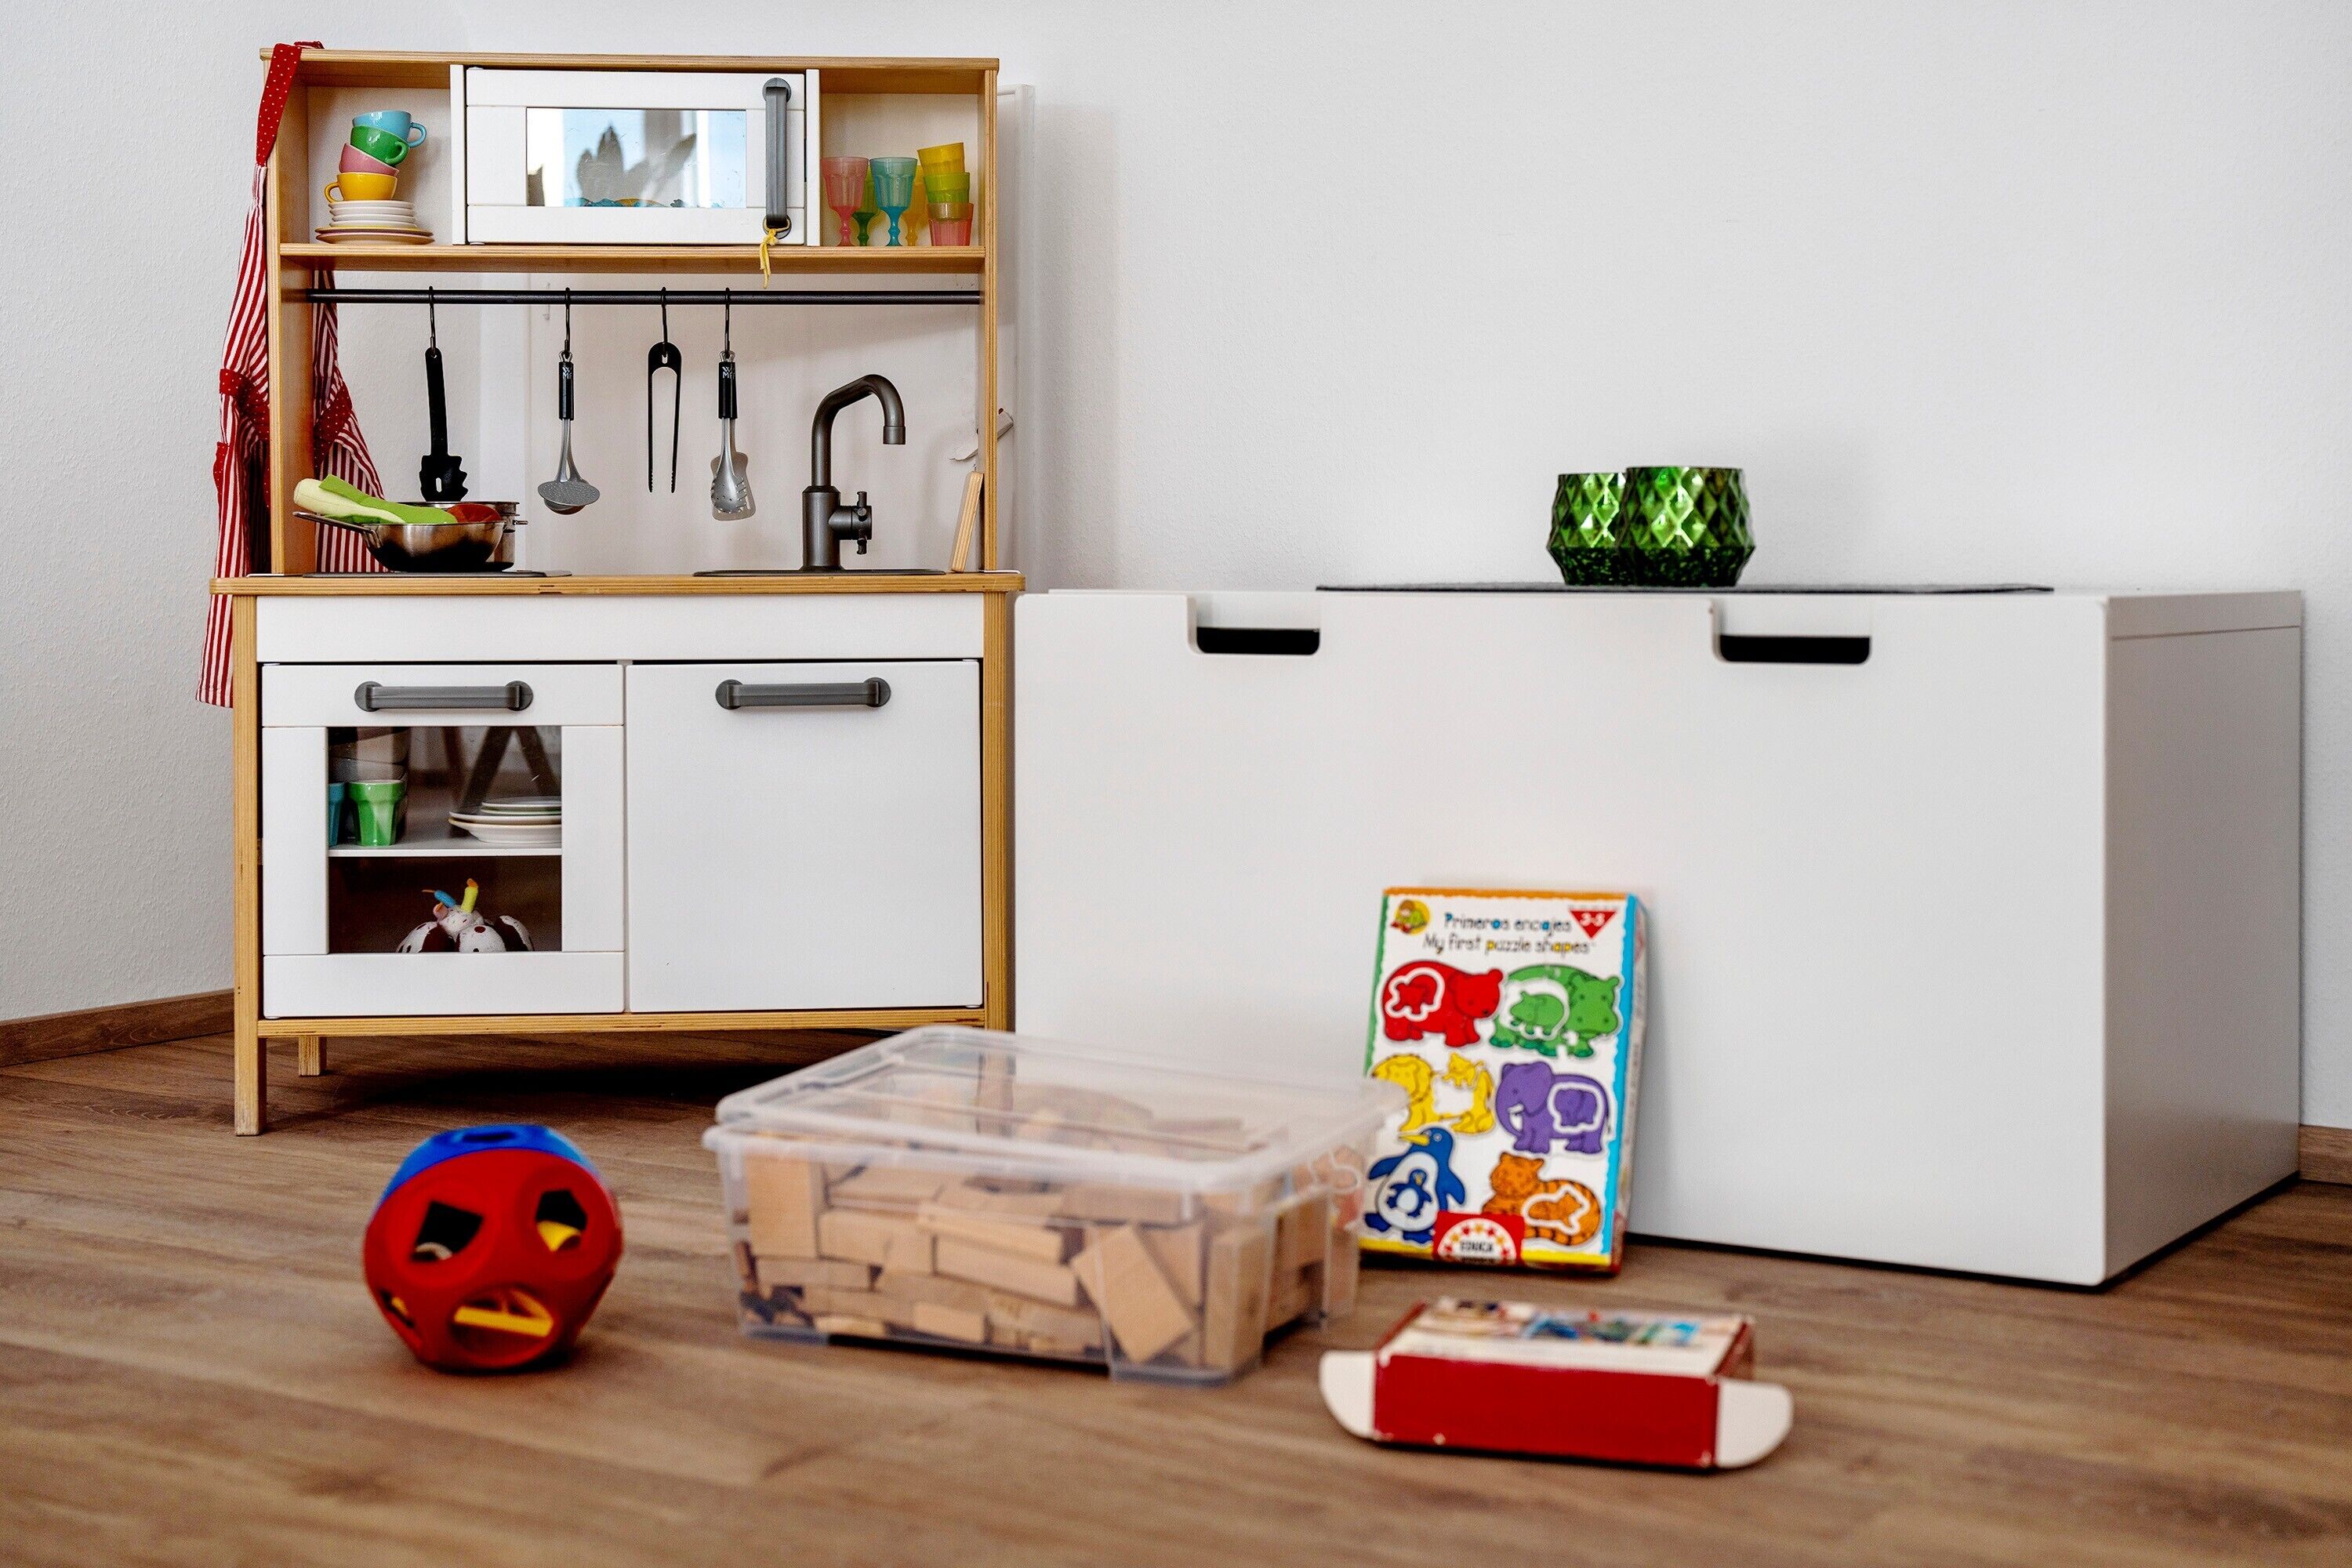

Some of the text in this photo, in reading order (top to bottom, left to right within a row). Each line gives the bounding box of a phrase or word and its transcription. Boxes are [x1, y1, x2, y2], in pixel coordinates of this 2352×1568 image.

[1444, 912, 1571, 935] Primeros encajes
[1423, 932, 1590, 958] My first puzzle shapes
